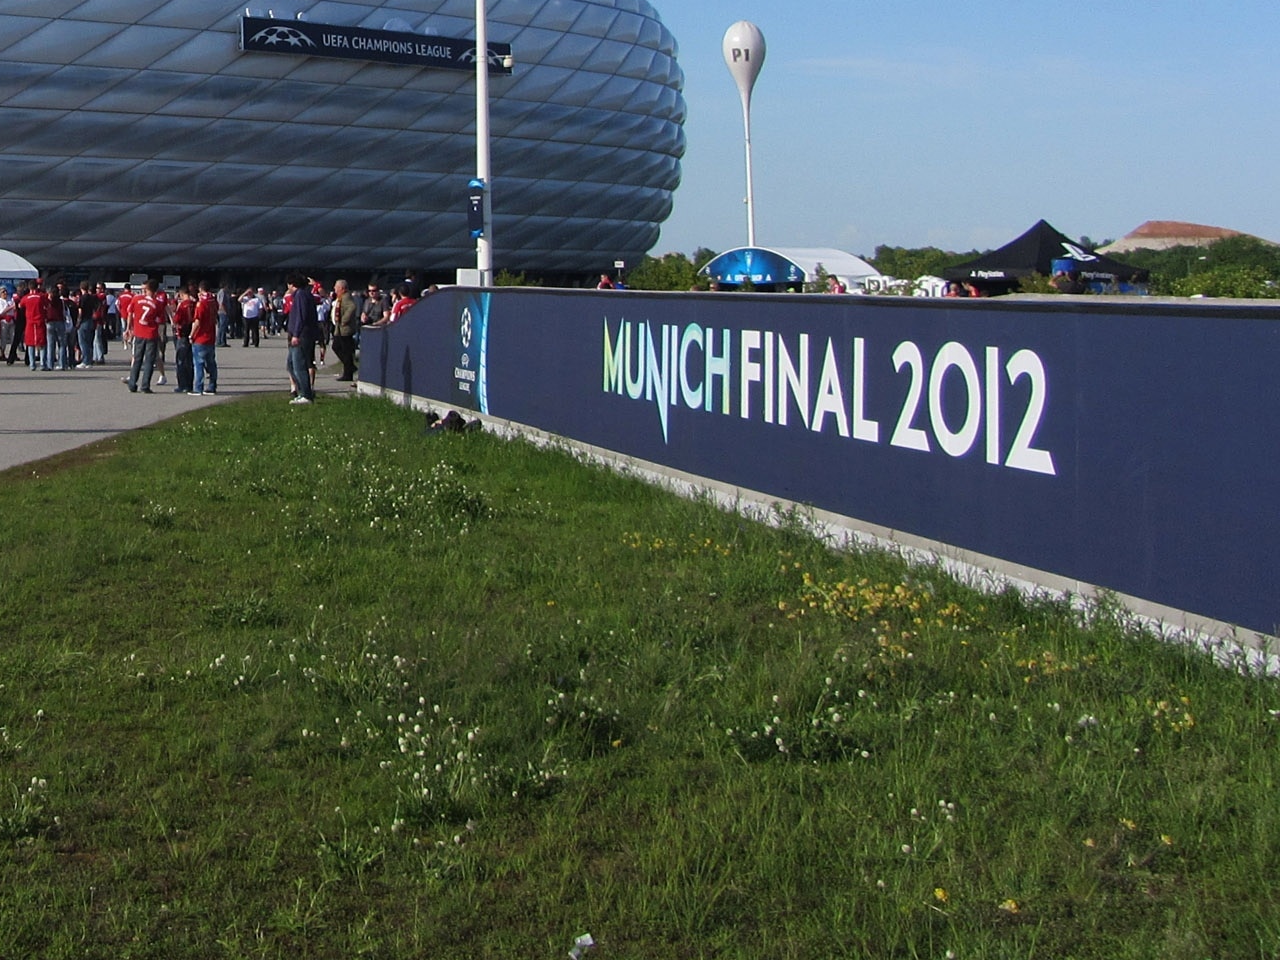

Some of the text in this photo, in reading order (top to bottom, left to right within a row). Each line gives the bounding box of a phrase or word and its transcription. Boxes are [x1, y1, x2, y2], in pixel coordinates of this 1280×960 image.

[322, 33, 452, 59] UEFA CHAMPIONS LEAGUE
[731, 48, 750, 62] P1
[141, 305, 150, 321] 7
[603, 316, 1057, 475] MUNICH FINAL 2012
